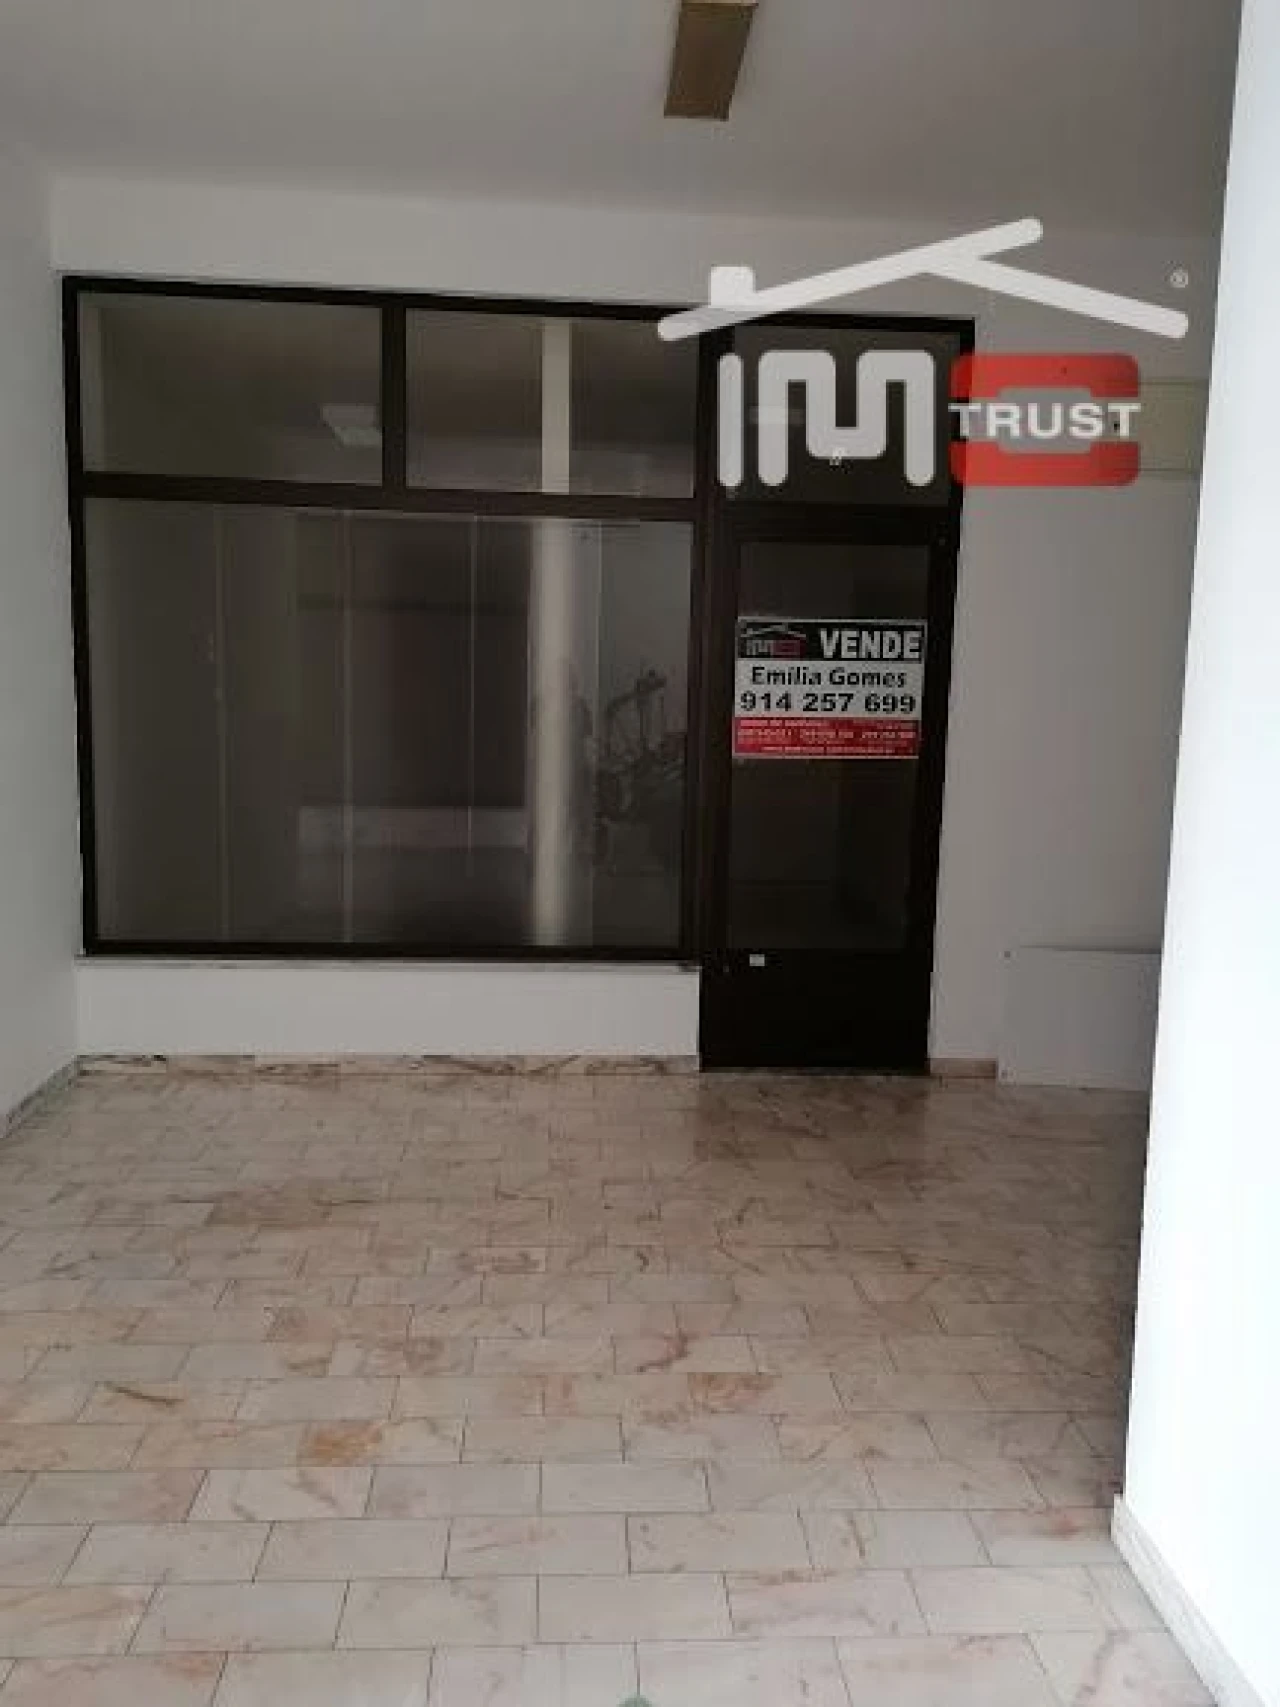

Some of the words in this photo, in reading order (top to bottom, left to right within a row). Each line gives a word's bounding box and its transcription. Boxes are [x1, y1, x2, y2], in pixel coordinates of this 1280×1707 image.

[820, 629, 922, 659] VENDE
[829, 667, 907, 688] Gomes
[740, 691, 792, 712] 914
[803, 692, 854, 712] 257
[864, 693, 916, 714] 699
